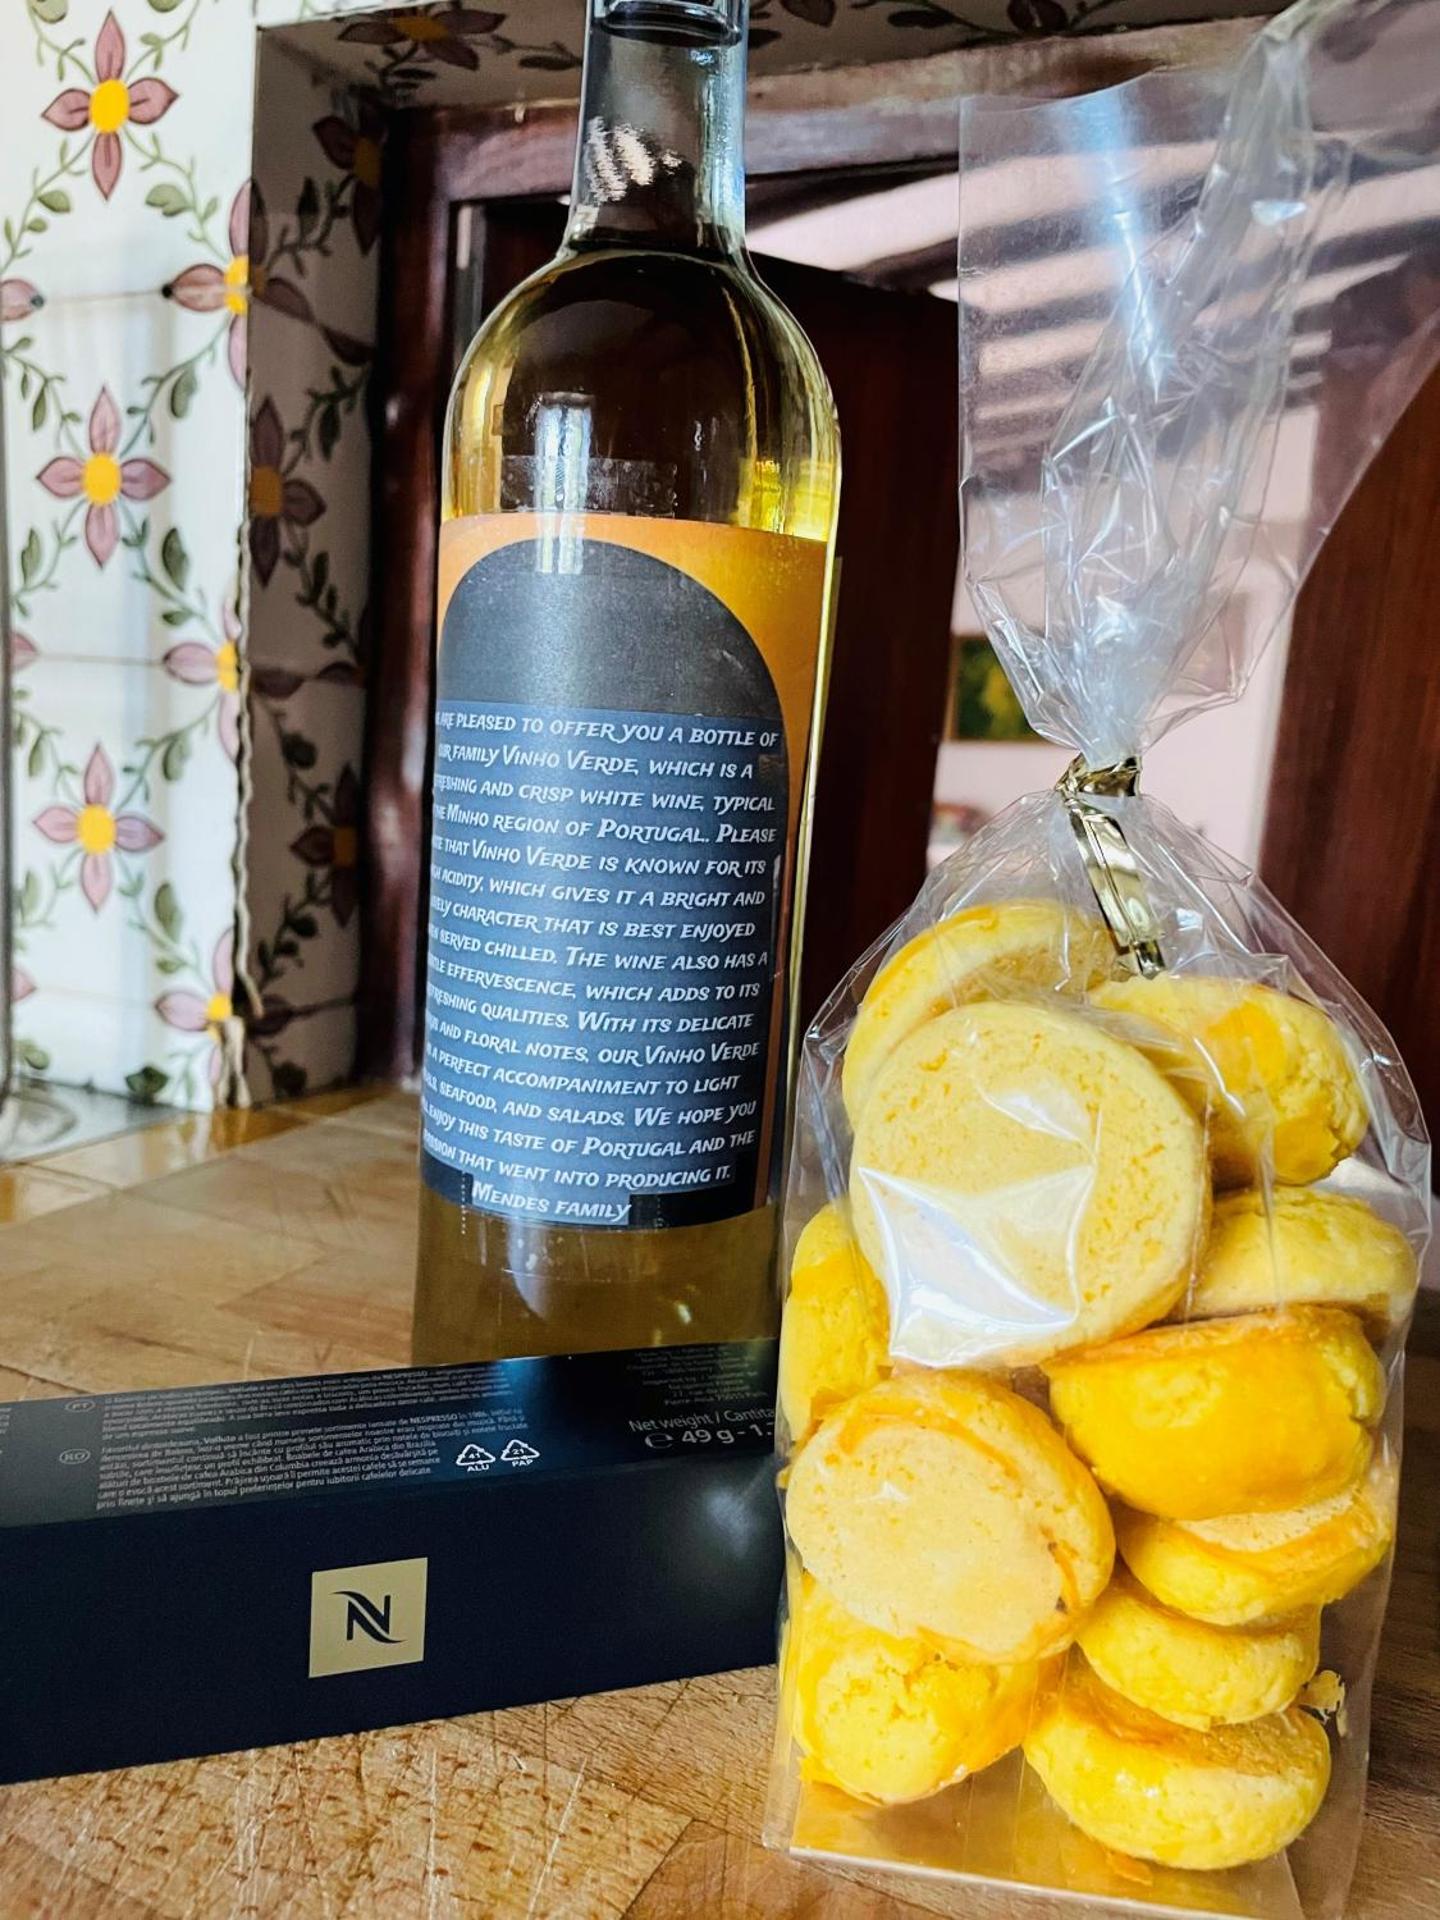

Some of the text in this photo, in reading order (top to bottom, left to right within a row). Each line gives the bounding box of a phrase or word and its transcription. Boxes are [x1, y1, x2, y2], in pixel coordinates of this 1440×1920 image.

[456, 712, 516, 730] PLEASED
[522, 718, 544, 733] TO
[550, 720, 622, 744] OFFER
[620, 723, 664, 744] YOU
[668, 727, 682, 744] A
[688, 728, 756, 746] BOTTLE
[760, 732, 778, 746] OF
[452, 745, 500, 767] FAMILY
[503, 745, 560, 768] VINHO
[568, 750, 638, 775] VERDE,
[650, 760, 715, 777] WHICH
[720, 764, 737, 778] IS
[740, 764, 752, 779] A
[480, 780, 514, 796] AND
[519, 784, 574, 804] CRISP
[580, 789, 645, 806] WHITE
[652, 793, 704, 812] WINE,
[714, 796, 775, 815] TYPICAL
[447, 804, 488, 826] MINHO
[493, 814, 560, 834] REGION
[566, 821, 593, 836] OF
[596, 818, 710, 844] PORTUGAL.
[716, 824, 776, 843] PLEASE
[444, 838, 470, 856] THAT
[472, 838, 520, 863] VINHO
[527, 846, 592, 871] VERDE
[599, 856, 619, 872] IS
[625, 858, 700, 874] KNOWN
[704, 860, 743, 878] FOR
[744, 860, 766, 874] ITS
[490, 878, 546, 898] WHICH
[552, 886, 610, 903] GIVES
[616, 890, 636, 904] IT
[639, 892, 654, 906] A
[660, 892, 731, 910] BRIGHT
[733, 891, 765, 906] AND
[453, 903, 542, 934] CHARACTER
[544, 917, 594, 934] THAT
[598, 922, 618, 936] IS
[624, 922, 677, 938] BEST
[680, 922, 756, 942] ENJOYED
[484, 942, 556, 962] CHILLED.
[566, 946, 608, 967] THE
[615, 954, 667, 970] WINE
[672, 955, 720, 970] ALSO
[724, 953, 756, 968] HAS
[758, 952, 768, 966] A
[447, 962, 576, 998] EFFERVESCENCE,
[586, 984, 653, 1001] WHICH
[658, 986, 710, 1002] ADDS
[716, 986, 735, 1000] TO
[739, 983, 760, 998] ITS
[481, 1002, 569, 1028] QUALITIES.
[578, 1011, 636, 1032] WITH
[642, 1018, 672, 1032] ITS
[676, 1014, 754, 1032] DELICATE
[440, 1022, 760, 1067] AND FLORAL NOTES, OUR VINHO VERDE
[439, 1050, 492, 1078] PERFECT
[493, 1068, 661, 1094] ACCOMPANIMENT
[666, 1080, 688, 1094] TO
[694, 1075, 740, 1093] LIGHT
[440, 1081, 496, 1113] SEAFOOD,
[503, 1101, 542, 1118] AND
[547, 1107, 624, 1126] SALADS.
[635, 1107, 673, 1126] WE
[678, 1108, 724, 1124] HOPE
[724, 1100, 756, 1124] YOU
[459, 1119, 488, 1139] THIS
[494, 1129, 546, 1150] TASTE
[550, 1138, 578, 1153] OF
[582, 1136, 686, 1160] PORTUGAL
[688, 1138, 725, 1154] AND
[730, 1130, 755, 1148] THE
[459, 1148, 496, 1174] THAT
[499, 1162, 550, 1182] WENT
[554, 1170, 599, 1186] INTO
[605, 1168, 711, 1190] PRODUCING
[716, 1165, 730, 1180] IT.
[472, 1180, 632, 1223] MENDES FAMILY
[628, 1419, 656, 1433] Net
[659, 1413, 714, 1430] weight
[714, 1411, 720, 1424] /
[681, 1429, 712, 1444] 49
[716, 1428, 735, 1444] g
[467, 1463, 490, 1473] ALU
[512, 1459, 534, 1468] PAP
